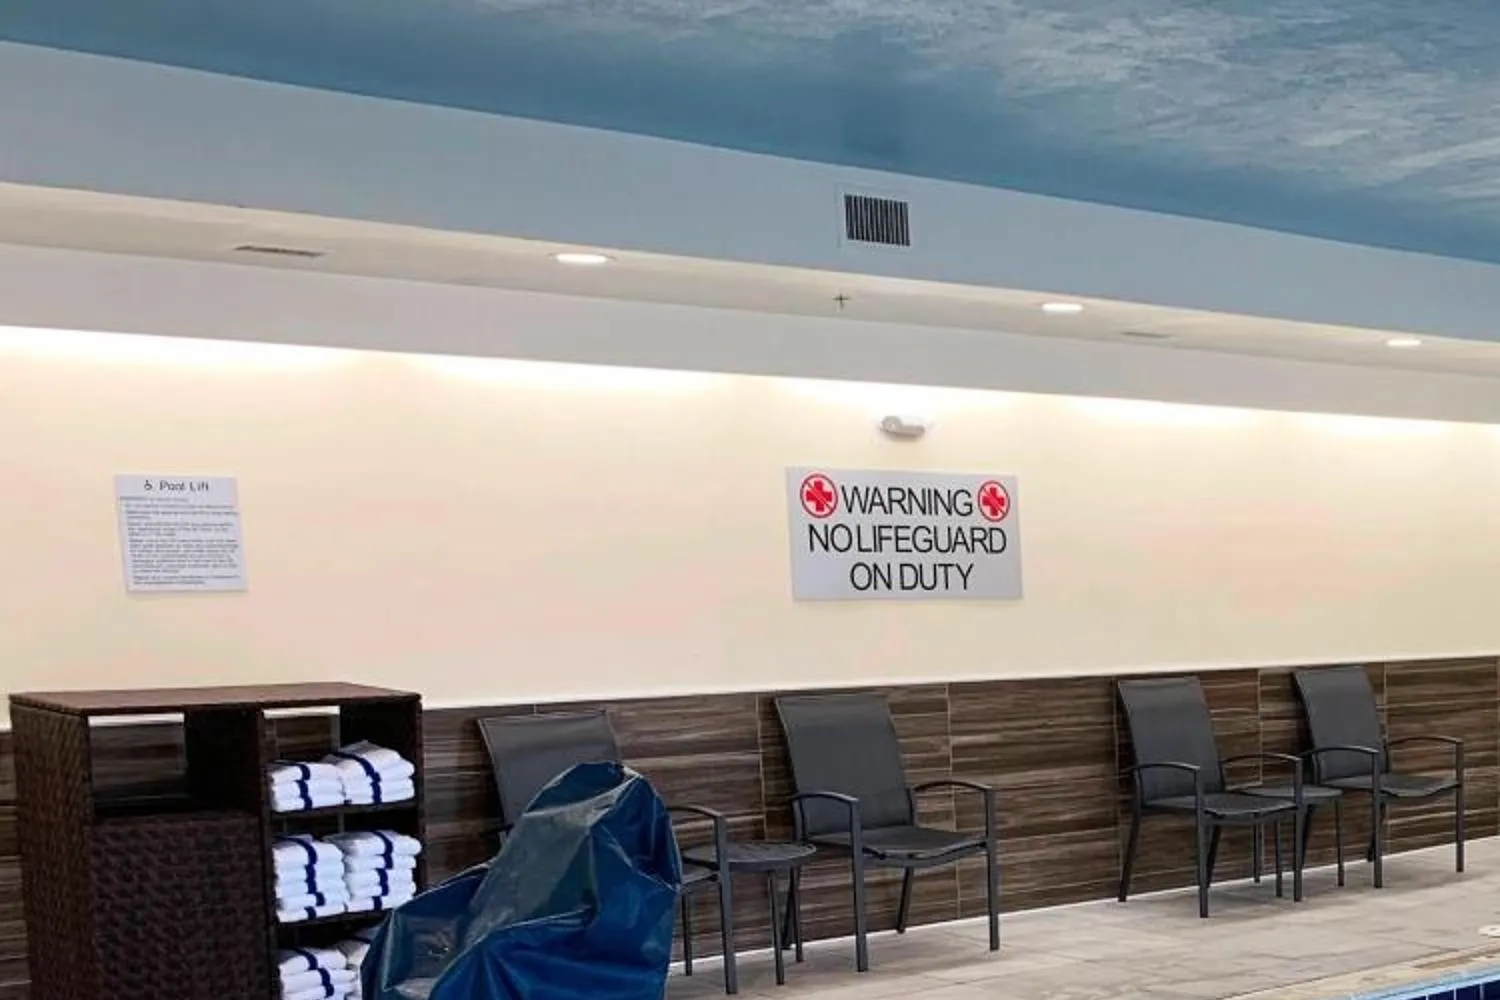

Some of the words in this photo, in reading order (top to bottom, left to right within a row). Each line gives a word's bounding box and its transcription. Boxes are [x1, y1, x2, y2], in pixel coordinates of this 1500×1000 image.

[841, 485, 973, 517] WARNING
[808, 523, 852, 553] NO
[857, 525, 1007, 554] LIFEGUARD
[850, 562, 892, 591] ON
[899, 563, 974, 591] DUTY
